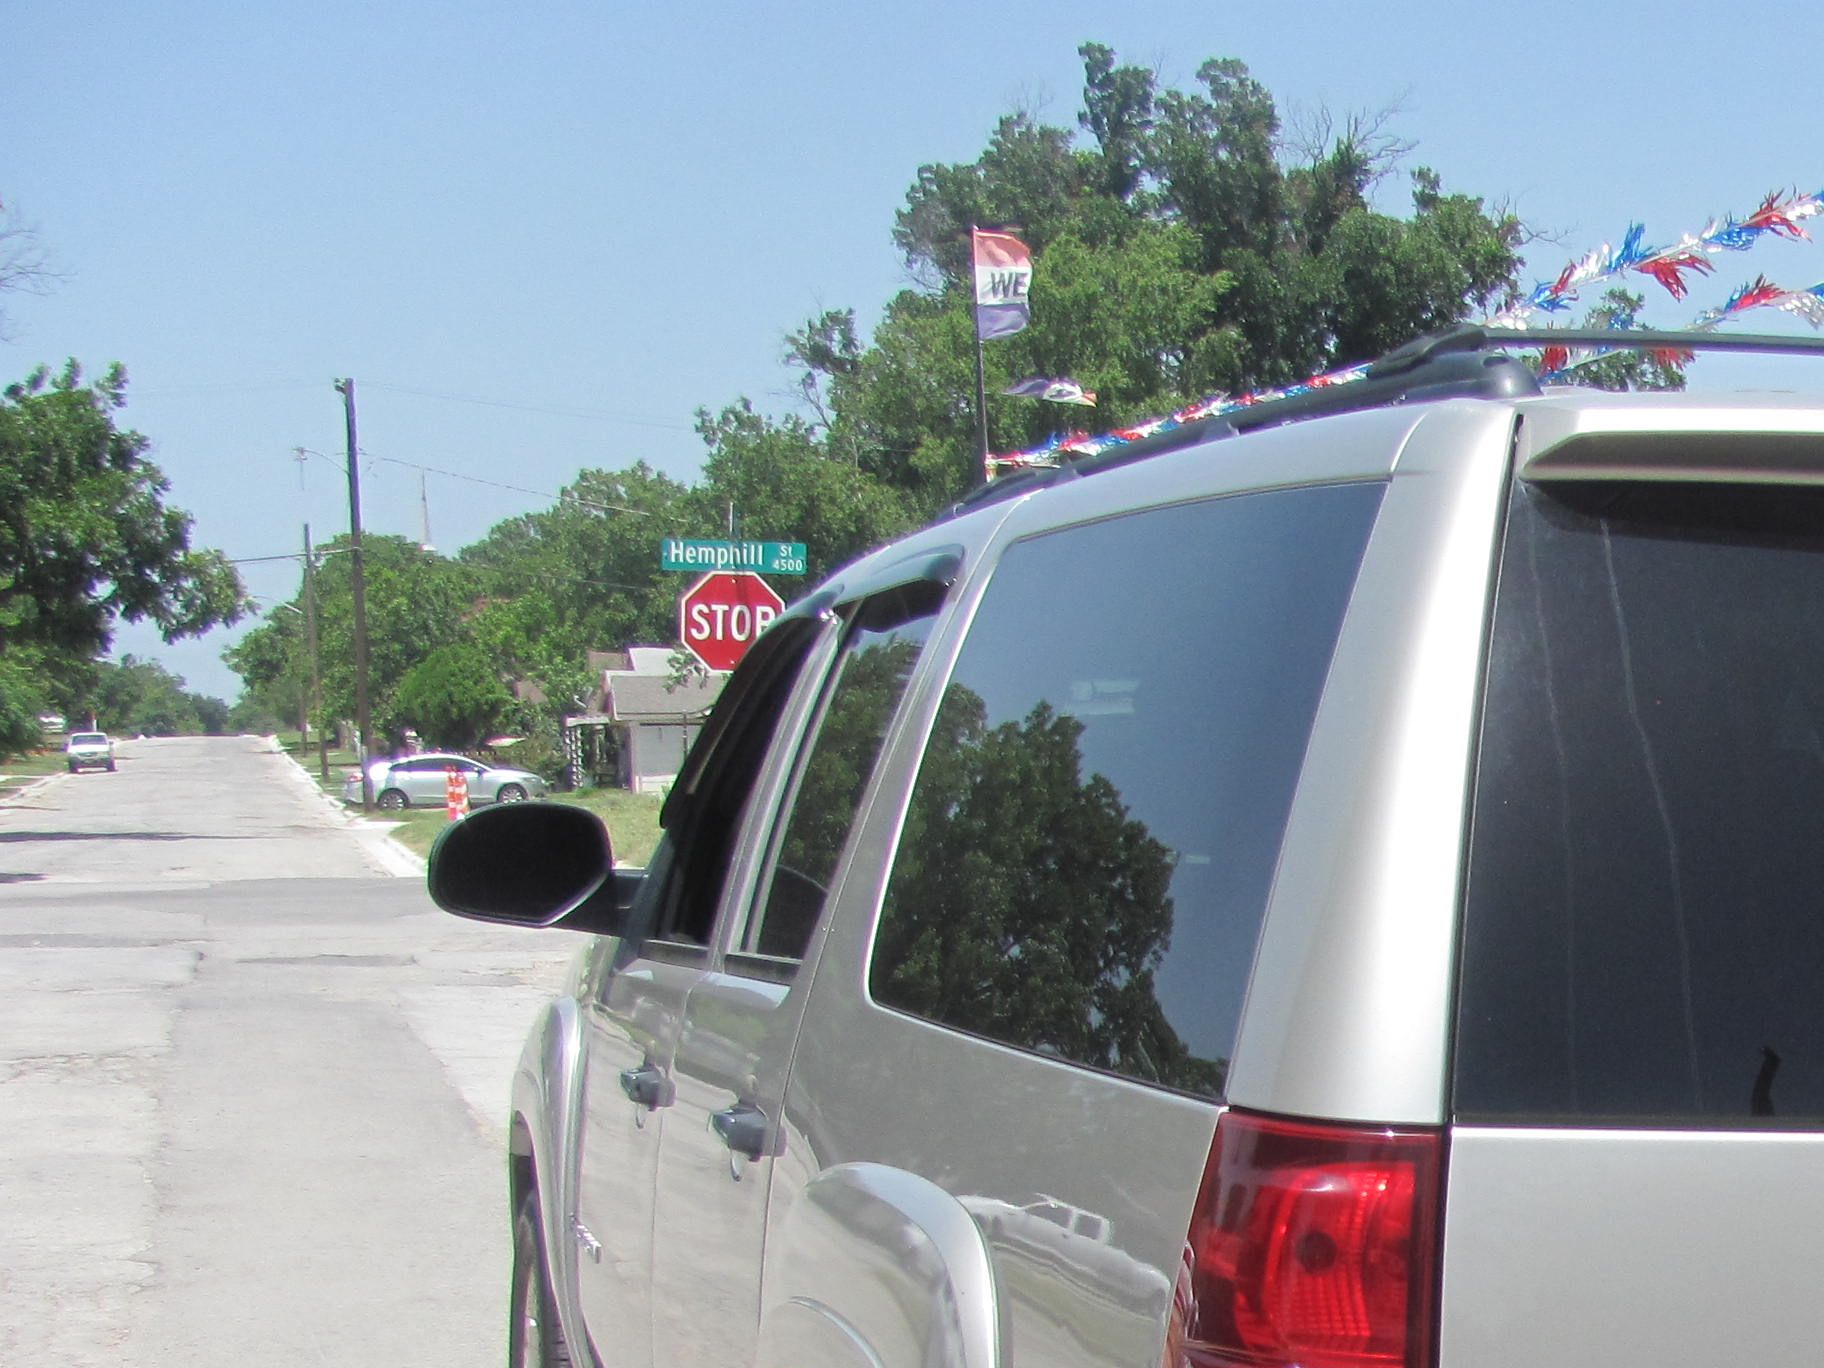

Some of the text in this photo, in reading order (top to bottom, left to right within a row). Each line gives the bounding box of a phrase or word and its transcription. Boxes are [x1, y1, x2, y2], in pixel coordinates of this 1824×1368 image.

[991, 271, 1028, 297] WE
[670, 541, 792, 569] Hemphill St
[772, 559, 803, 571] 4500
[690, 603, 776, 641] STOP
